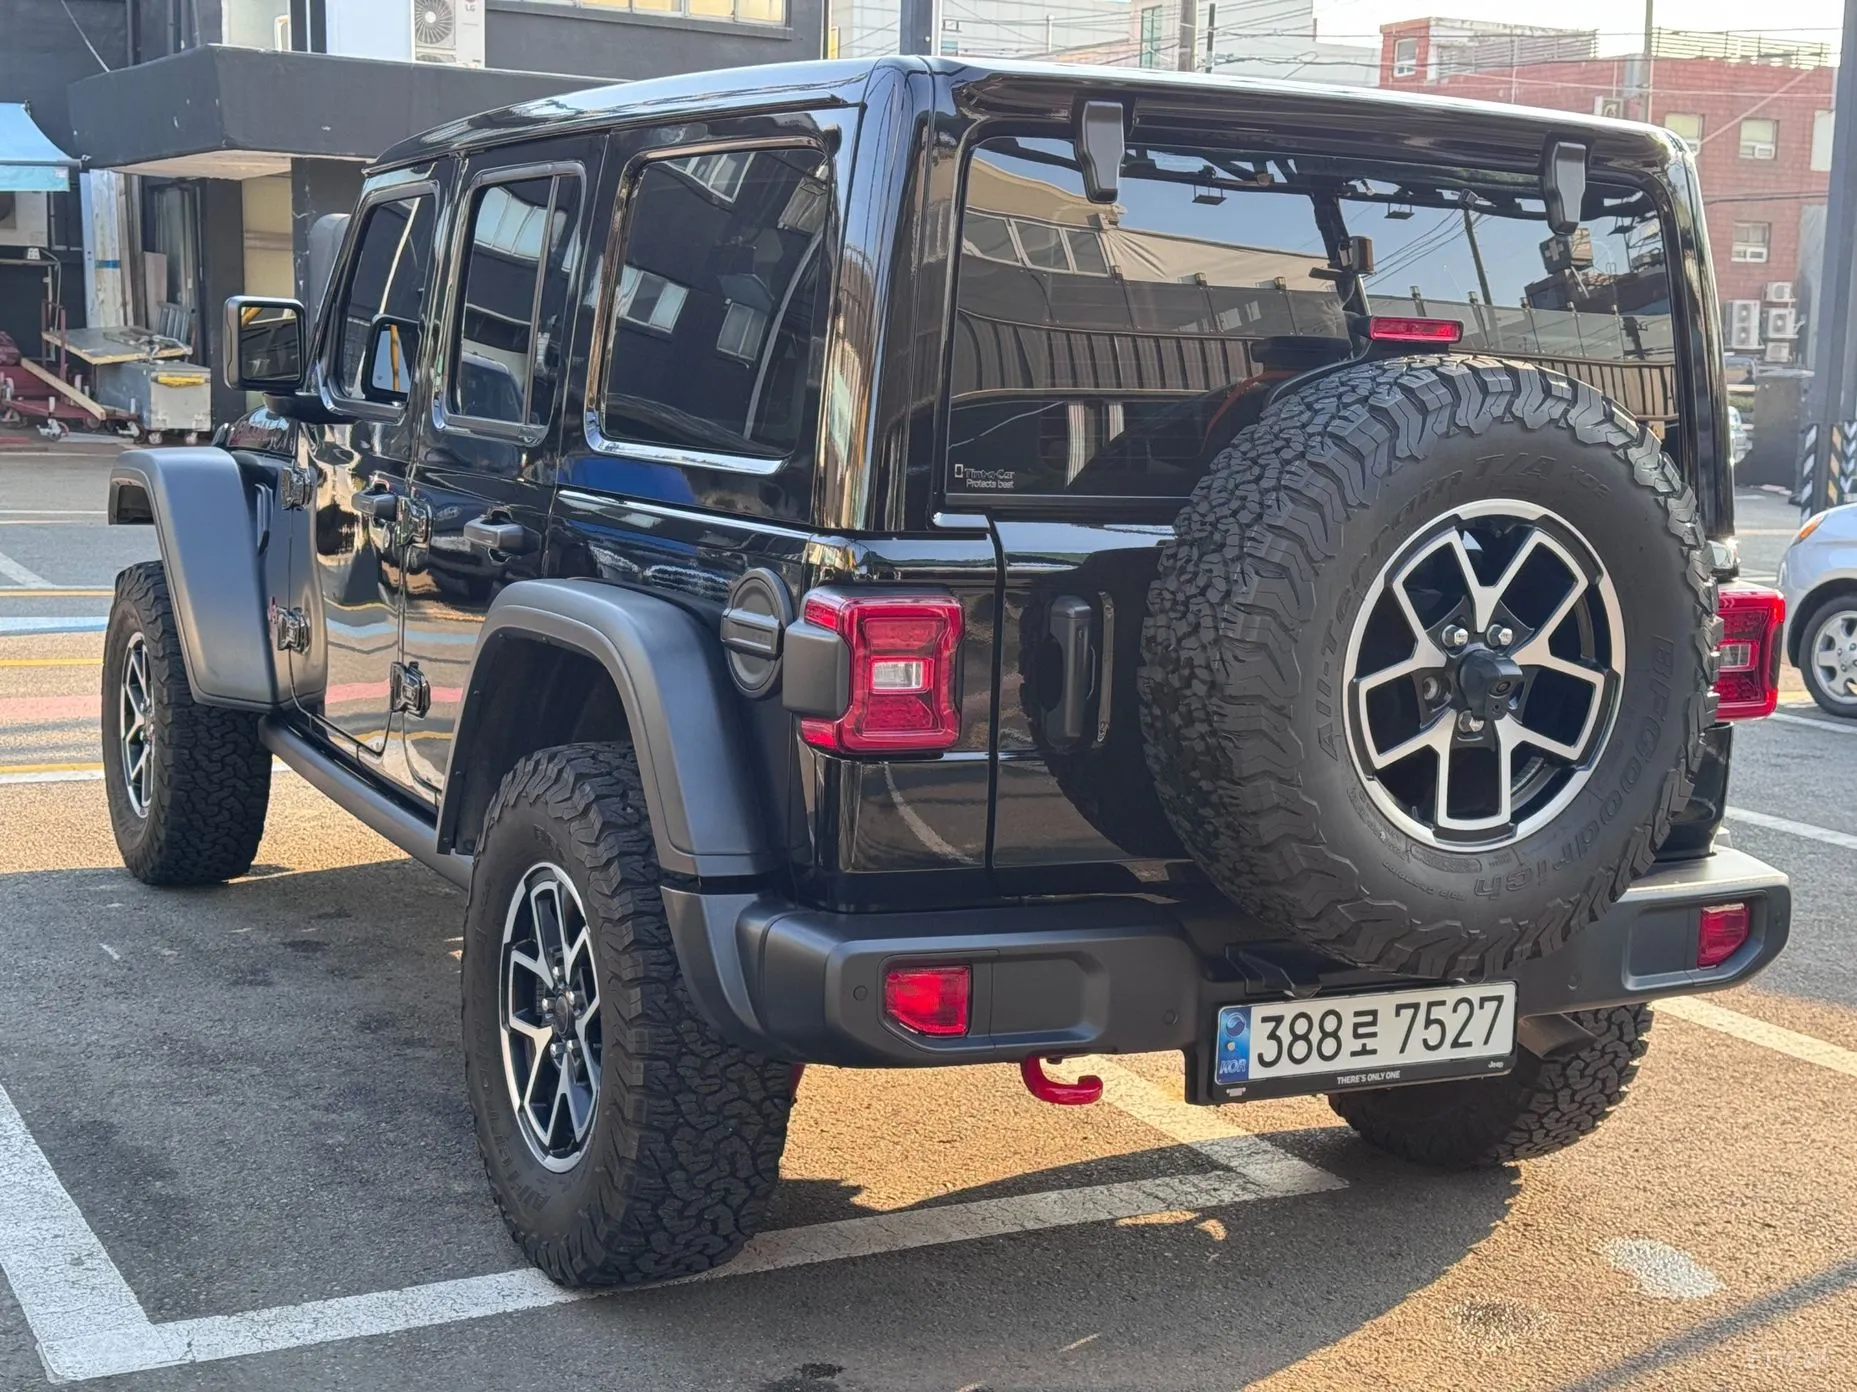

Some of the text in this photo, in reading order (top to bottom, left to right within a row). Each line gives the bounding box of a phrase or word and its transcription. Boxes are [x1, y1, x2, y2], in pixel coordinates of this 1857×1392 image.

[998, 480, 1015, 489] best
[1257, 994, 1505, 1068] 388로 7527
[1219, 1058, 1247, 1075] KOR
[1336, 1070, 1401, 1085] THERE'S ONLY ONE
